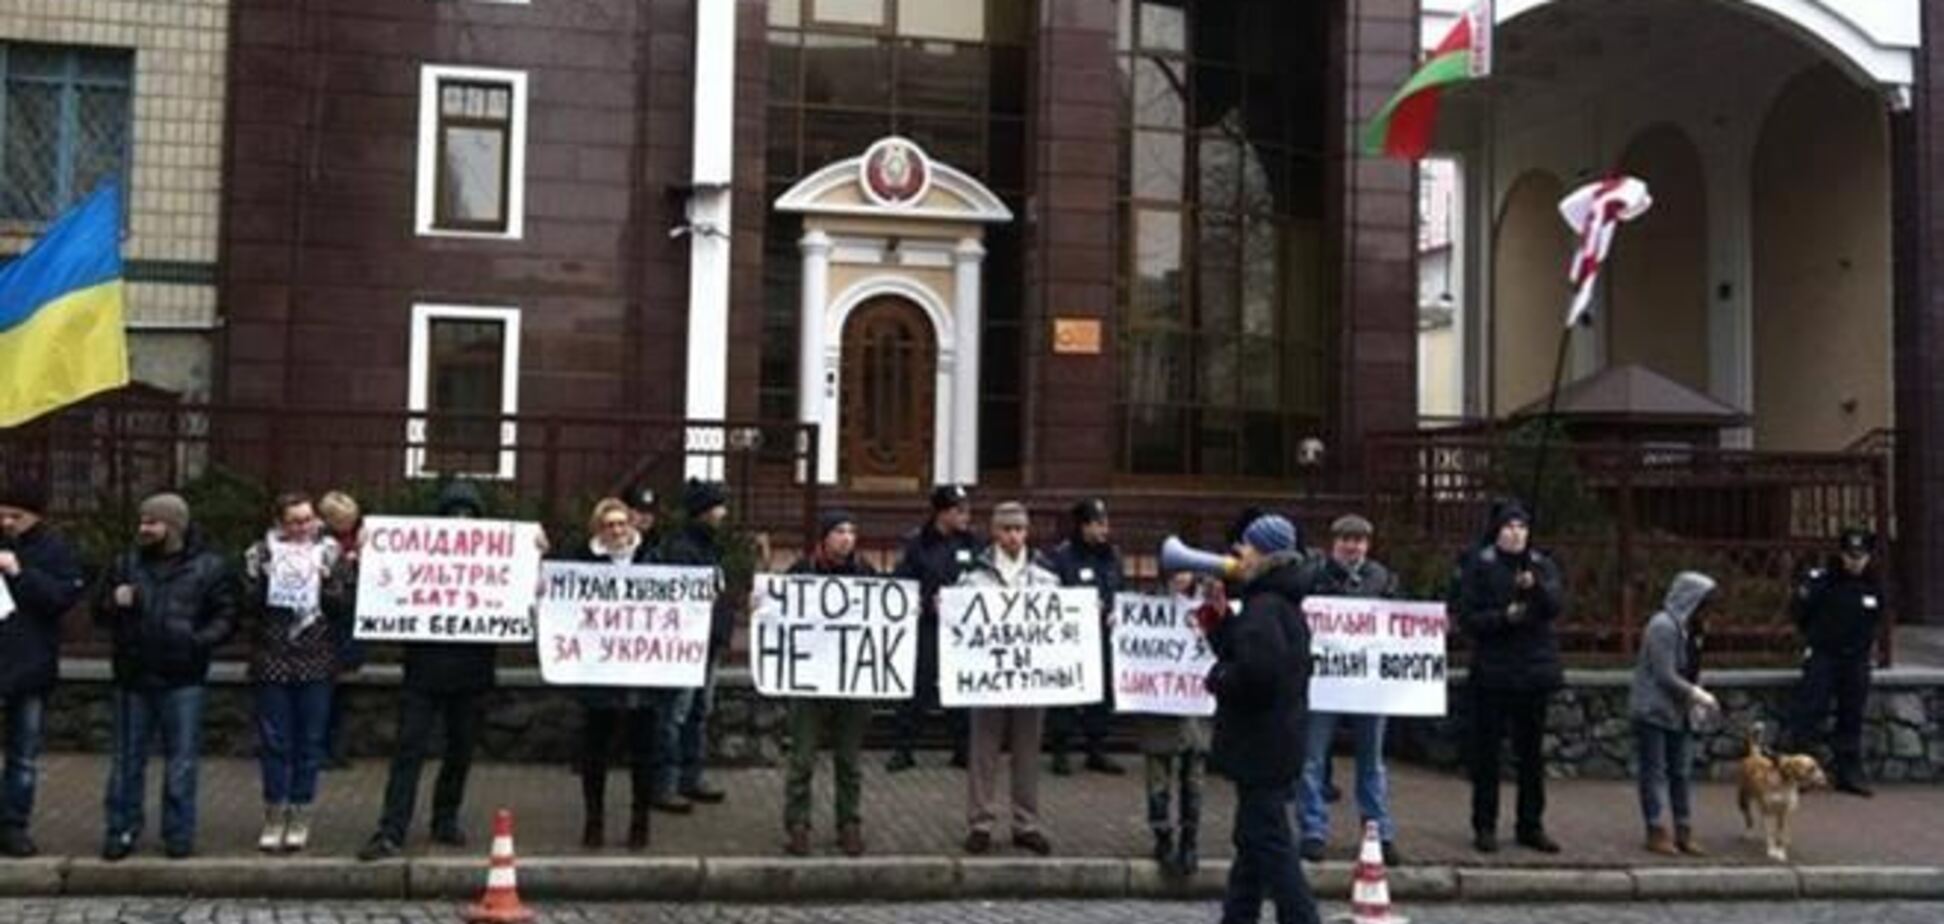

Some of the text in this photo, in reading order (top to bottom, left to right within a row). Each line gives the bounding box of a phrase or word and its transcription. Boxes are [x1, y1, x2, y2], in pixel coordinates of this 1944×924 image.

[371, 525, 515, 557] СОЛІДАРНІ
[407, 563, 510, 586] УЛЬТРАС
[767, 577, 908, 623] ЧТО-ТО
[580, 605, 680, 630] ЖИТТЯ
[553, 634, 705, 663] ЗА УКРАЇНУ
[758, 622, 906, 693] НЕ ТАК
[989, 647, 1031, 669] ТЫ
